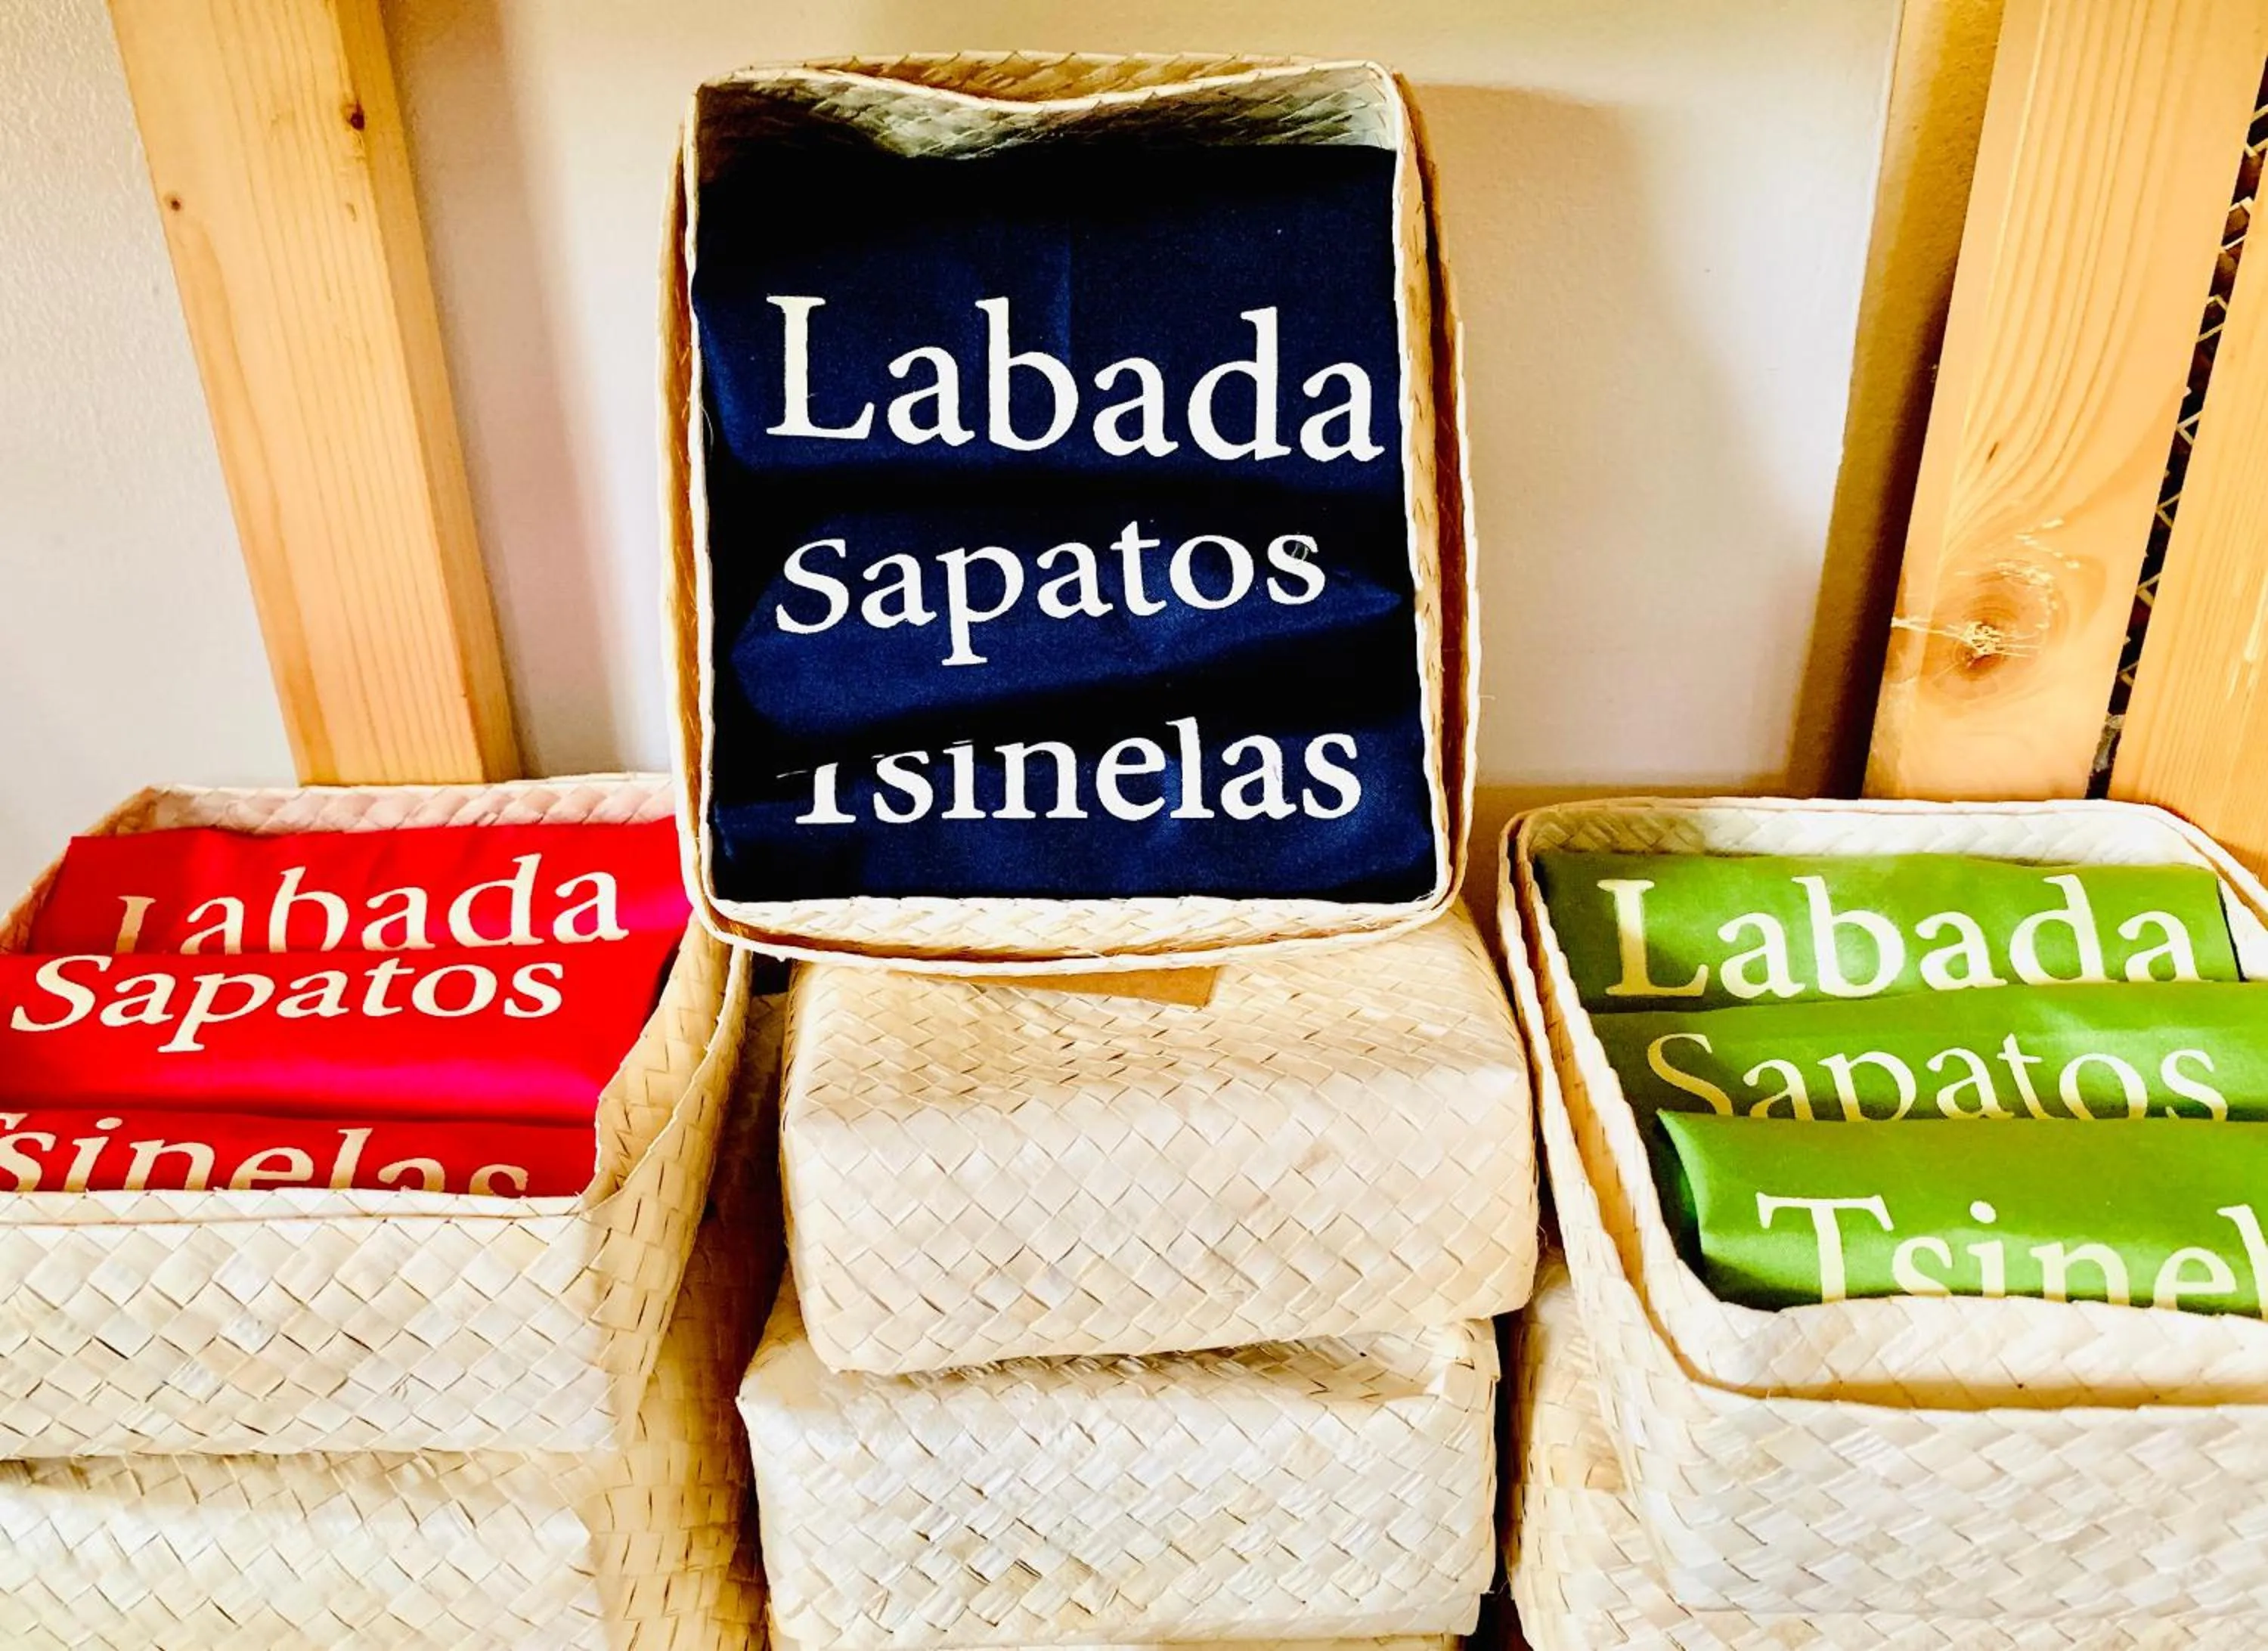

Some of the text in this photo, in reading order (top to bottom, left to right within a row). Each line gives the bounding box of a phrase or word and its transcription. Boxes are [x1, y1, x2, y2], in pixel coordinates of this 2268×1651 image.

[767, 296, 1384, 462] Labada
[776, 522, 1326, 665] Sapatos
[1597, 874, 2213, 998] Labada
[11, 955, 563, 1052] Sapatos
[1647, 1033, 2228, 1122] Sapatos
[0, 1112, 528, 1196] sinel
